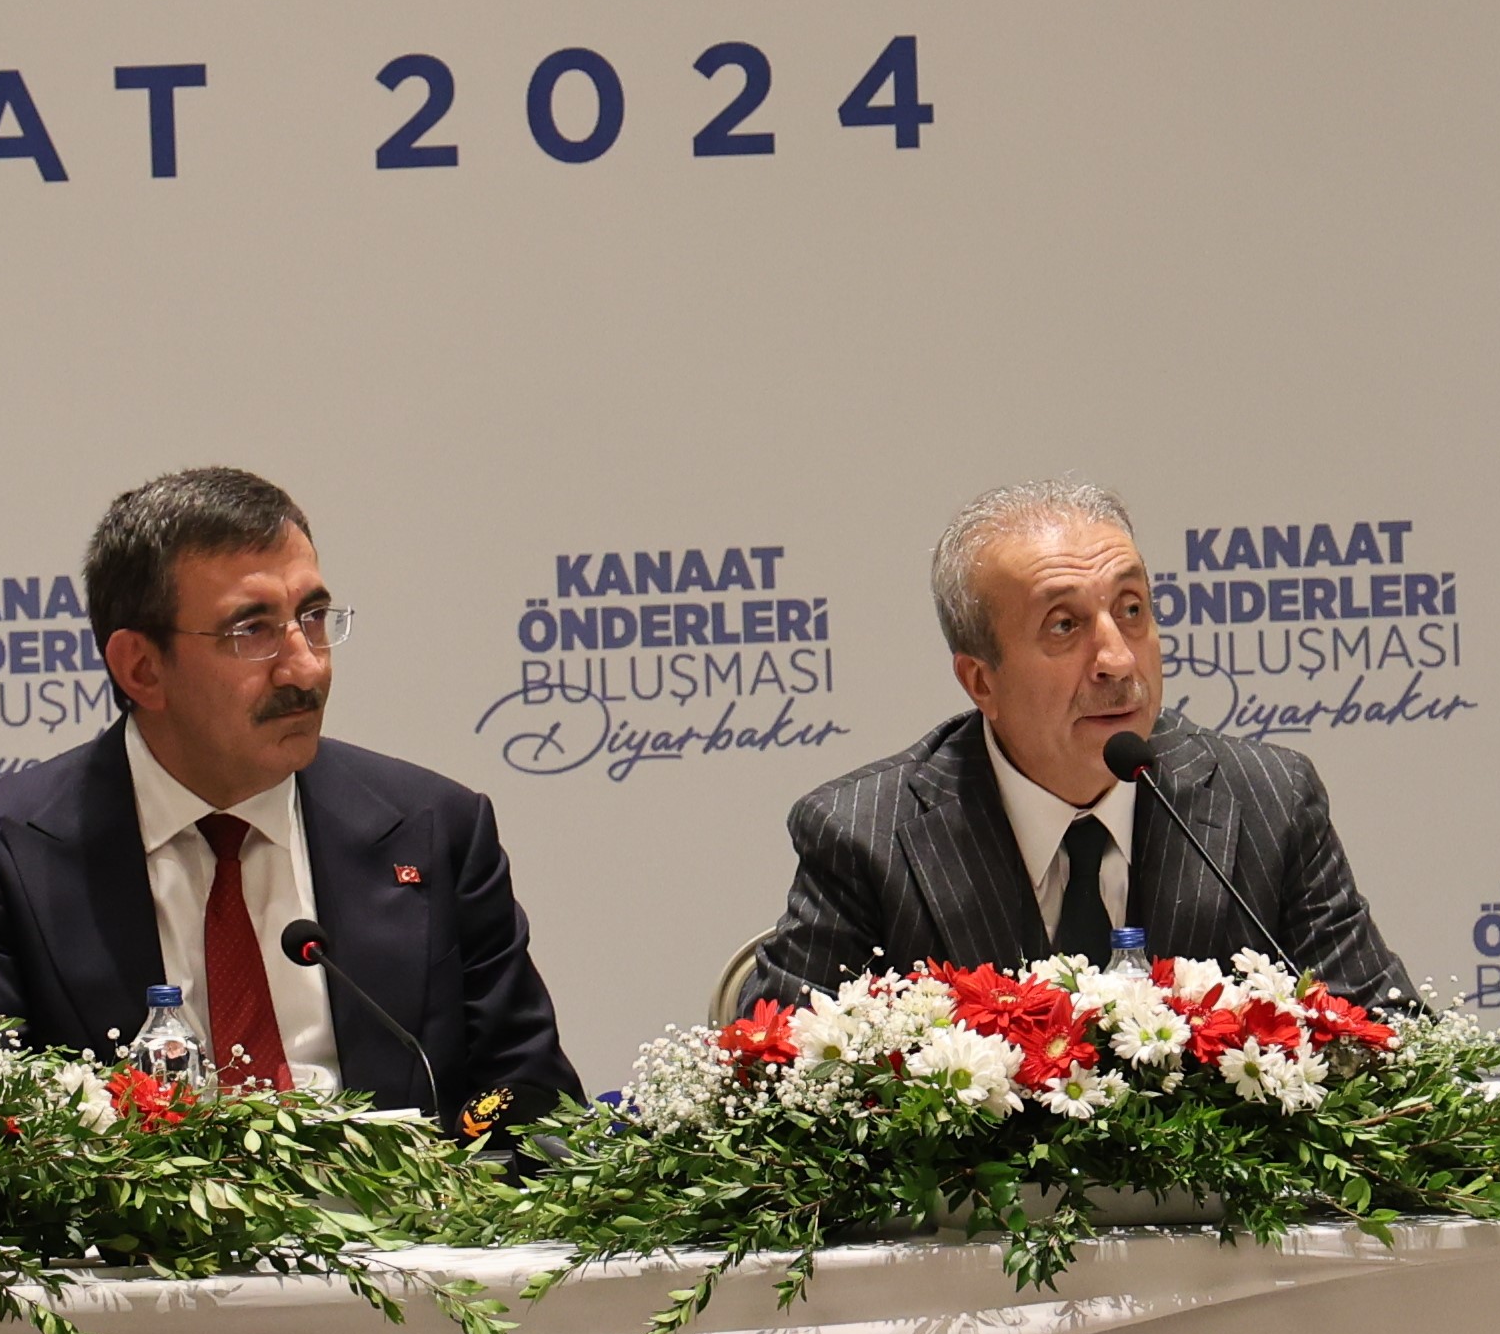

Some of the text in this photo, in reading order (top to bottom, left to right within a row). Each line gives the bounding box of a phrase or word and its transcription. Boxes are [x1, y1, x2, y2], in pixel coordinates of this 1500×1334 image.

[377, 37, 933, 170] 2024
[555, 546, 785, 598] KANAAT
[1185, 520, 1413, 572] KANAAT
[517, 597, 830, 653] ÖNDERLERİ
[1153, 572, 1457, 627] ÖNDERLERİ
[521, 648, 834, 707] BULUŞMASI
[1160, 622, 1461, 680] BULUŞMASI
[475, 685, 852, 783] Diyarbakır
